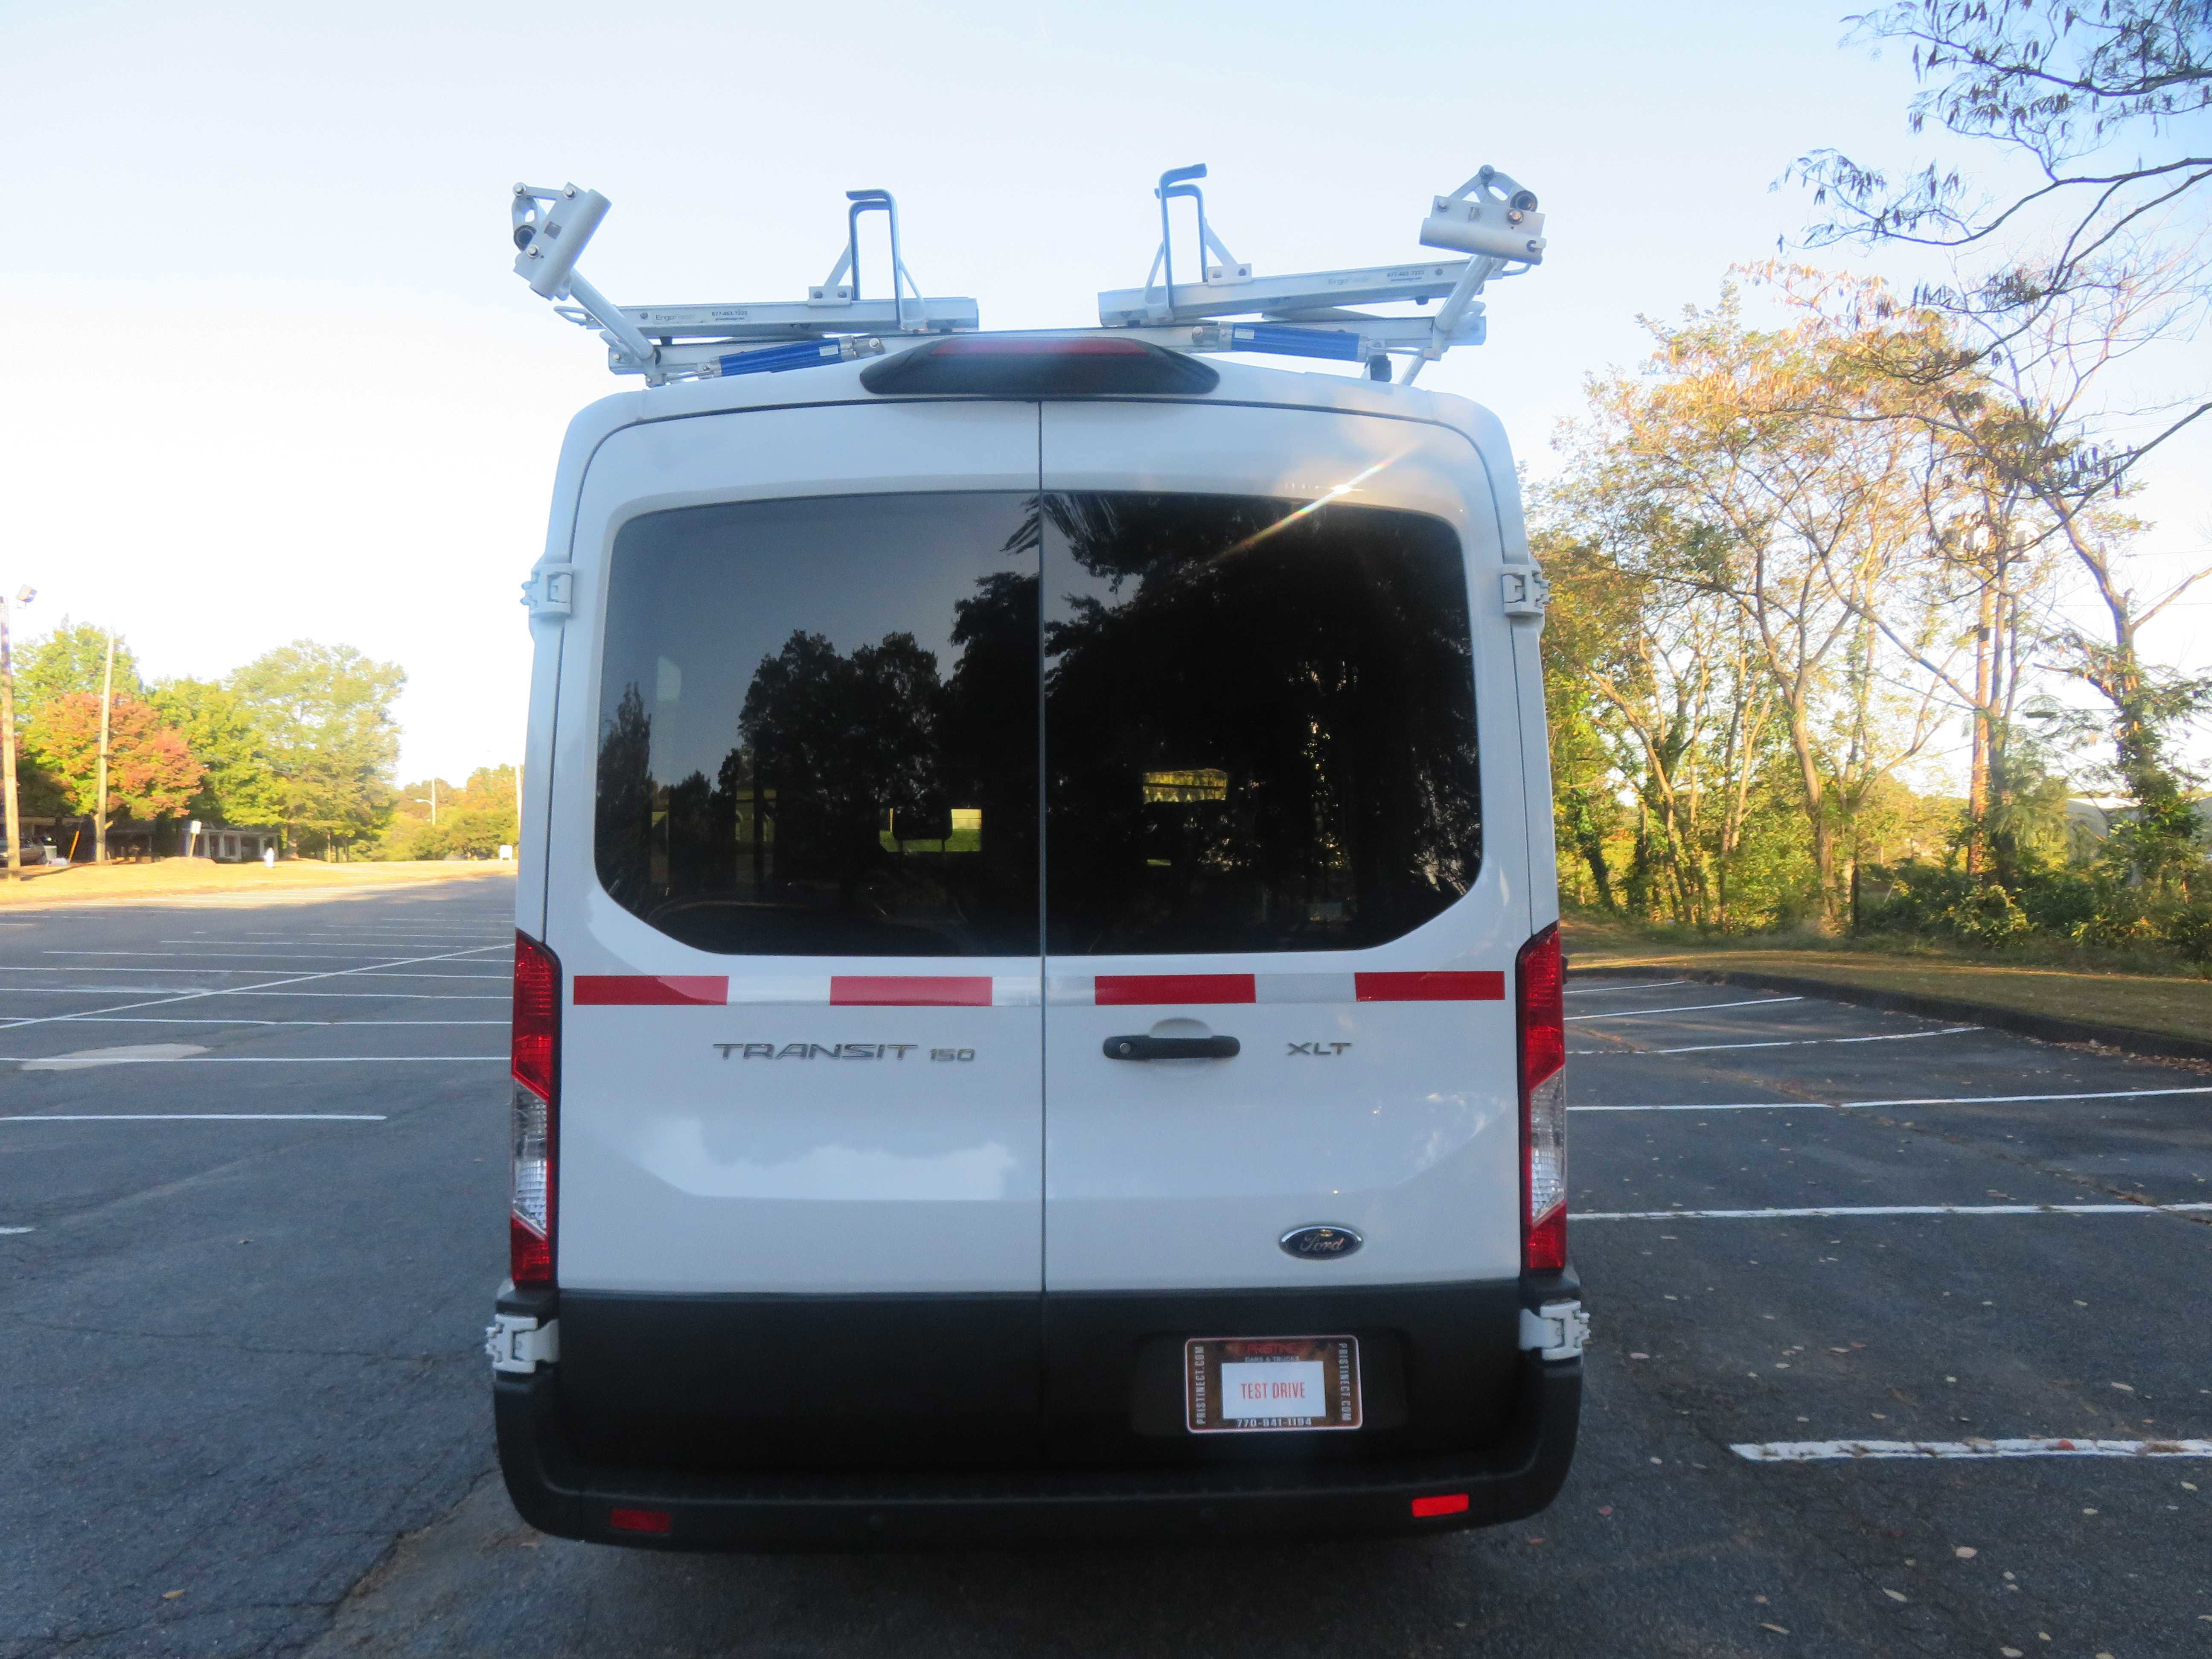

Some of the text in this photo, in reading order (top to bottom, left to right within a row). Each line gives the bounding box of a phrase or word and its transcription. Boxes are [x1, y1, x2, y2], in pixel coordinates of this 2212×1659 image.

[713, 1043, 976, 1062] TRANSIT 150
[1286, 1042, 1352, 1056] XLT
[1300, 1233, 1345, 1252] Ford
[1195, 1346, 1206, 1424] PRISTINECT.COM
[1241, 1381, 1306, 1399] TEST DRIVE
[1339, 1342, 1352, 1421] PRISTINECT.COM
